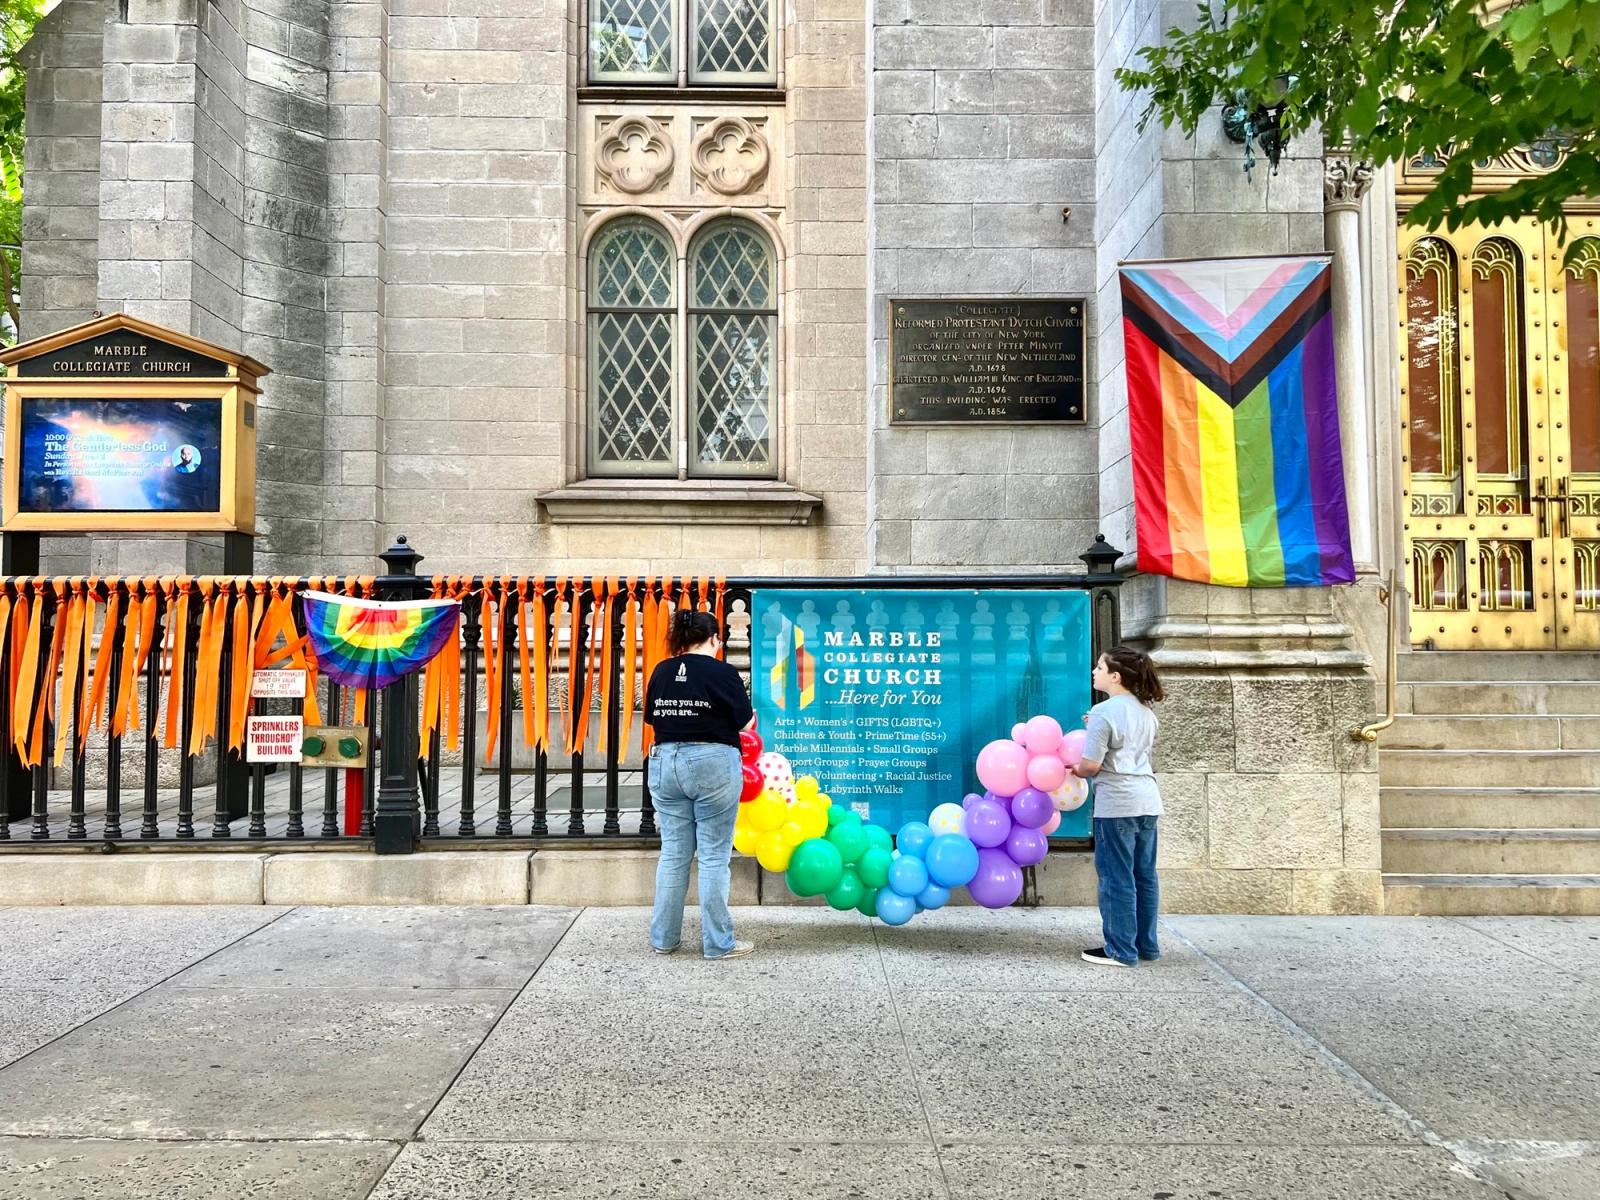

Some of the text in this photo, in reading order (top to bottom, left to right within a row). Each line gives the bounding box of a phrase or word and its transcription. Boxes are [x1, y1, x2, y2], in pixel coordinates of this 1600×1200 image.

[895, 317, 943, 328] REFORMED
[944, 316, 1006, 328] PROTESTANT
[930, 330, 1046, 339] OF THE CITY OF NEW YORK
[94, 345, 147, 356] MARBLE
[998, 342, 1025, 350] PETER
[900, 354, 937, 362] DIRECTOR
[996, 353, 1018, 361] NEW
[1020, 353, 1076, 361] NETHERLAND
[53, 361, 191, 372] COLLEGIATE CHURCH
[940, 375, 950, 383] BY
[953, 374, 990, 383] WILLIAM
[1002, 374, 1021, 383] KING
[1024, 375, 1035, 383] OF
[1036, 374, 1074, 383] ENGLAND
[986, 386, 1006, 394] 1696
[920, 396, 940, 404] THIS
[992, 396, 1012, 404] WAS
[1019, 396, 1057, 404] ERECTED
[45, 441, 69, 452] The
[142, 441, 168, 452] God
[823, 631, 941, 647] MARBLE
[823, 652, 941, 663] COLLEGIATE
[823, 668, 941, 685] CHURCH
[678, 699, 694, 708] you
[694, 700, 712, 709] are,
[825, 689, 942, 708] ...Here for You
[661, 709, 678, 718] you
[252, 721, 299, 732] SPRINKLERS
[774, 717, 942, 728] Arts Women's GIFTS (LGBTQ+)
[774, 731, 947, 742] Children & Youth PrimeTime (55+)
[257, 745, 293, 756] BUILDING
[774, 743, 939, 756] Marble Millennials Small Groups
[813, 758, 849, 769] Groups
[858, 758, 890, 768] Prayer
[891, 758, 927, 769] Groups
[815, 771, 877, 781] Volunteering
[885, 771, 916, 780] Racial
[916, 771, 953, 781] Justice
[824, 784, 904, 795] Labyrinth Walks
